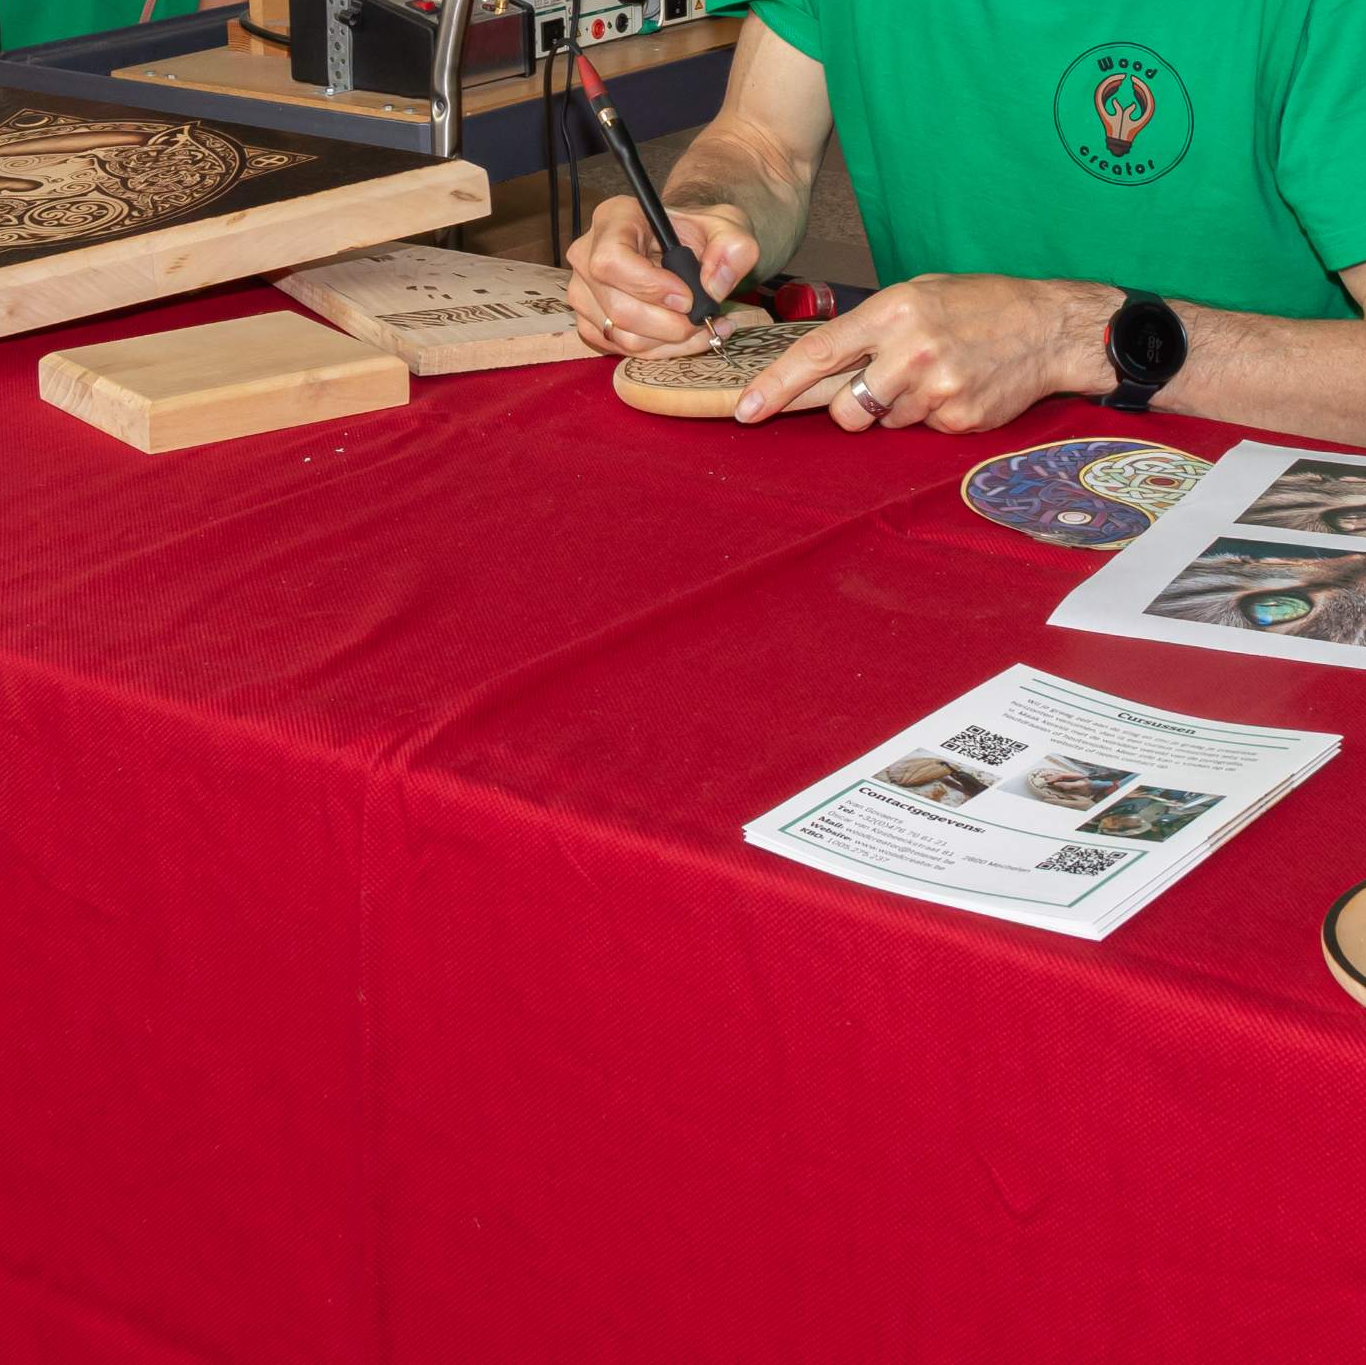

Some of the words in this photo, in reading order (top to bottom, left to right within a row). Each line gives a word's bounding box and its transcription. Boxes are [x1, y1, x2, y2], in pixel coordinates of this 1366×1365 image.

[1097, 56, 1158, 79] Wood
[1079, 145, 1155, 176] creator
[1116, 711, 1197, 735] Cursussen
[837, 804, 856, 815] Tel:
[858, 785, 988, 835] Contactgegevens:
[810, 821, 853, 841] Website:
[818, 815, 844, 829] Mail:
[799, 826, 825, 840] KBO:
